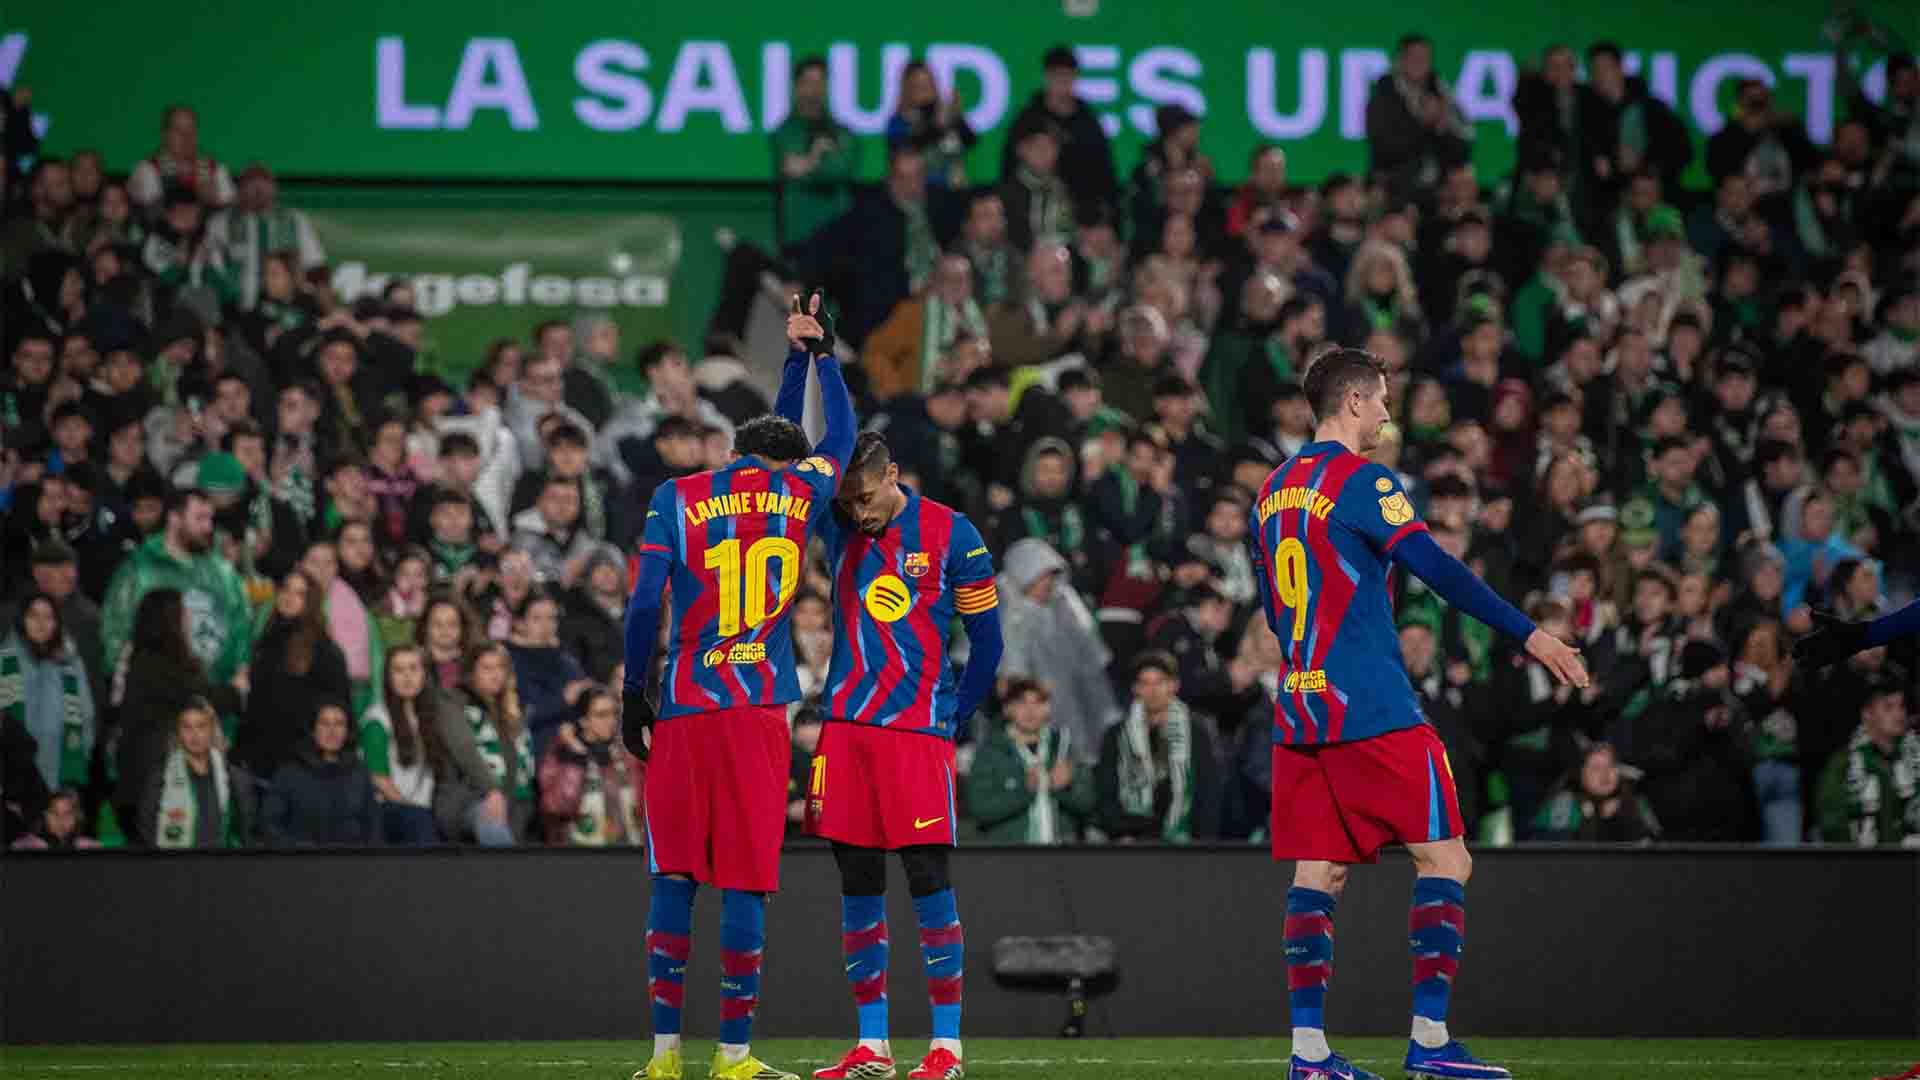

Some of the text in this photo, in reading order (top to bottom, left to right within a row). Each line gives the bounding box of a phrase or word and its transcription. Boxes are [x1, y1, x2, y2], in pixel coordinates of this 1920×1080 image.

[375, 36, 541, 131] LA
[572, 37, 1011, 134] SALUD
[1577, 52, 1887, 145] ICT
[331, 260, 668, 318] gefesa
[685, 491, 811, 527] LAMINE YAMAL
[1260, 486, 1336, 528] EWANDOWSKI
[703, 537, 800, 637] 10
[1275, 537, 1309, 641] 9
